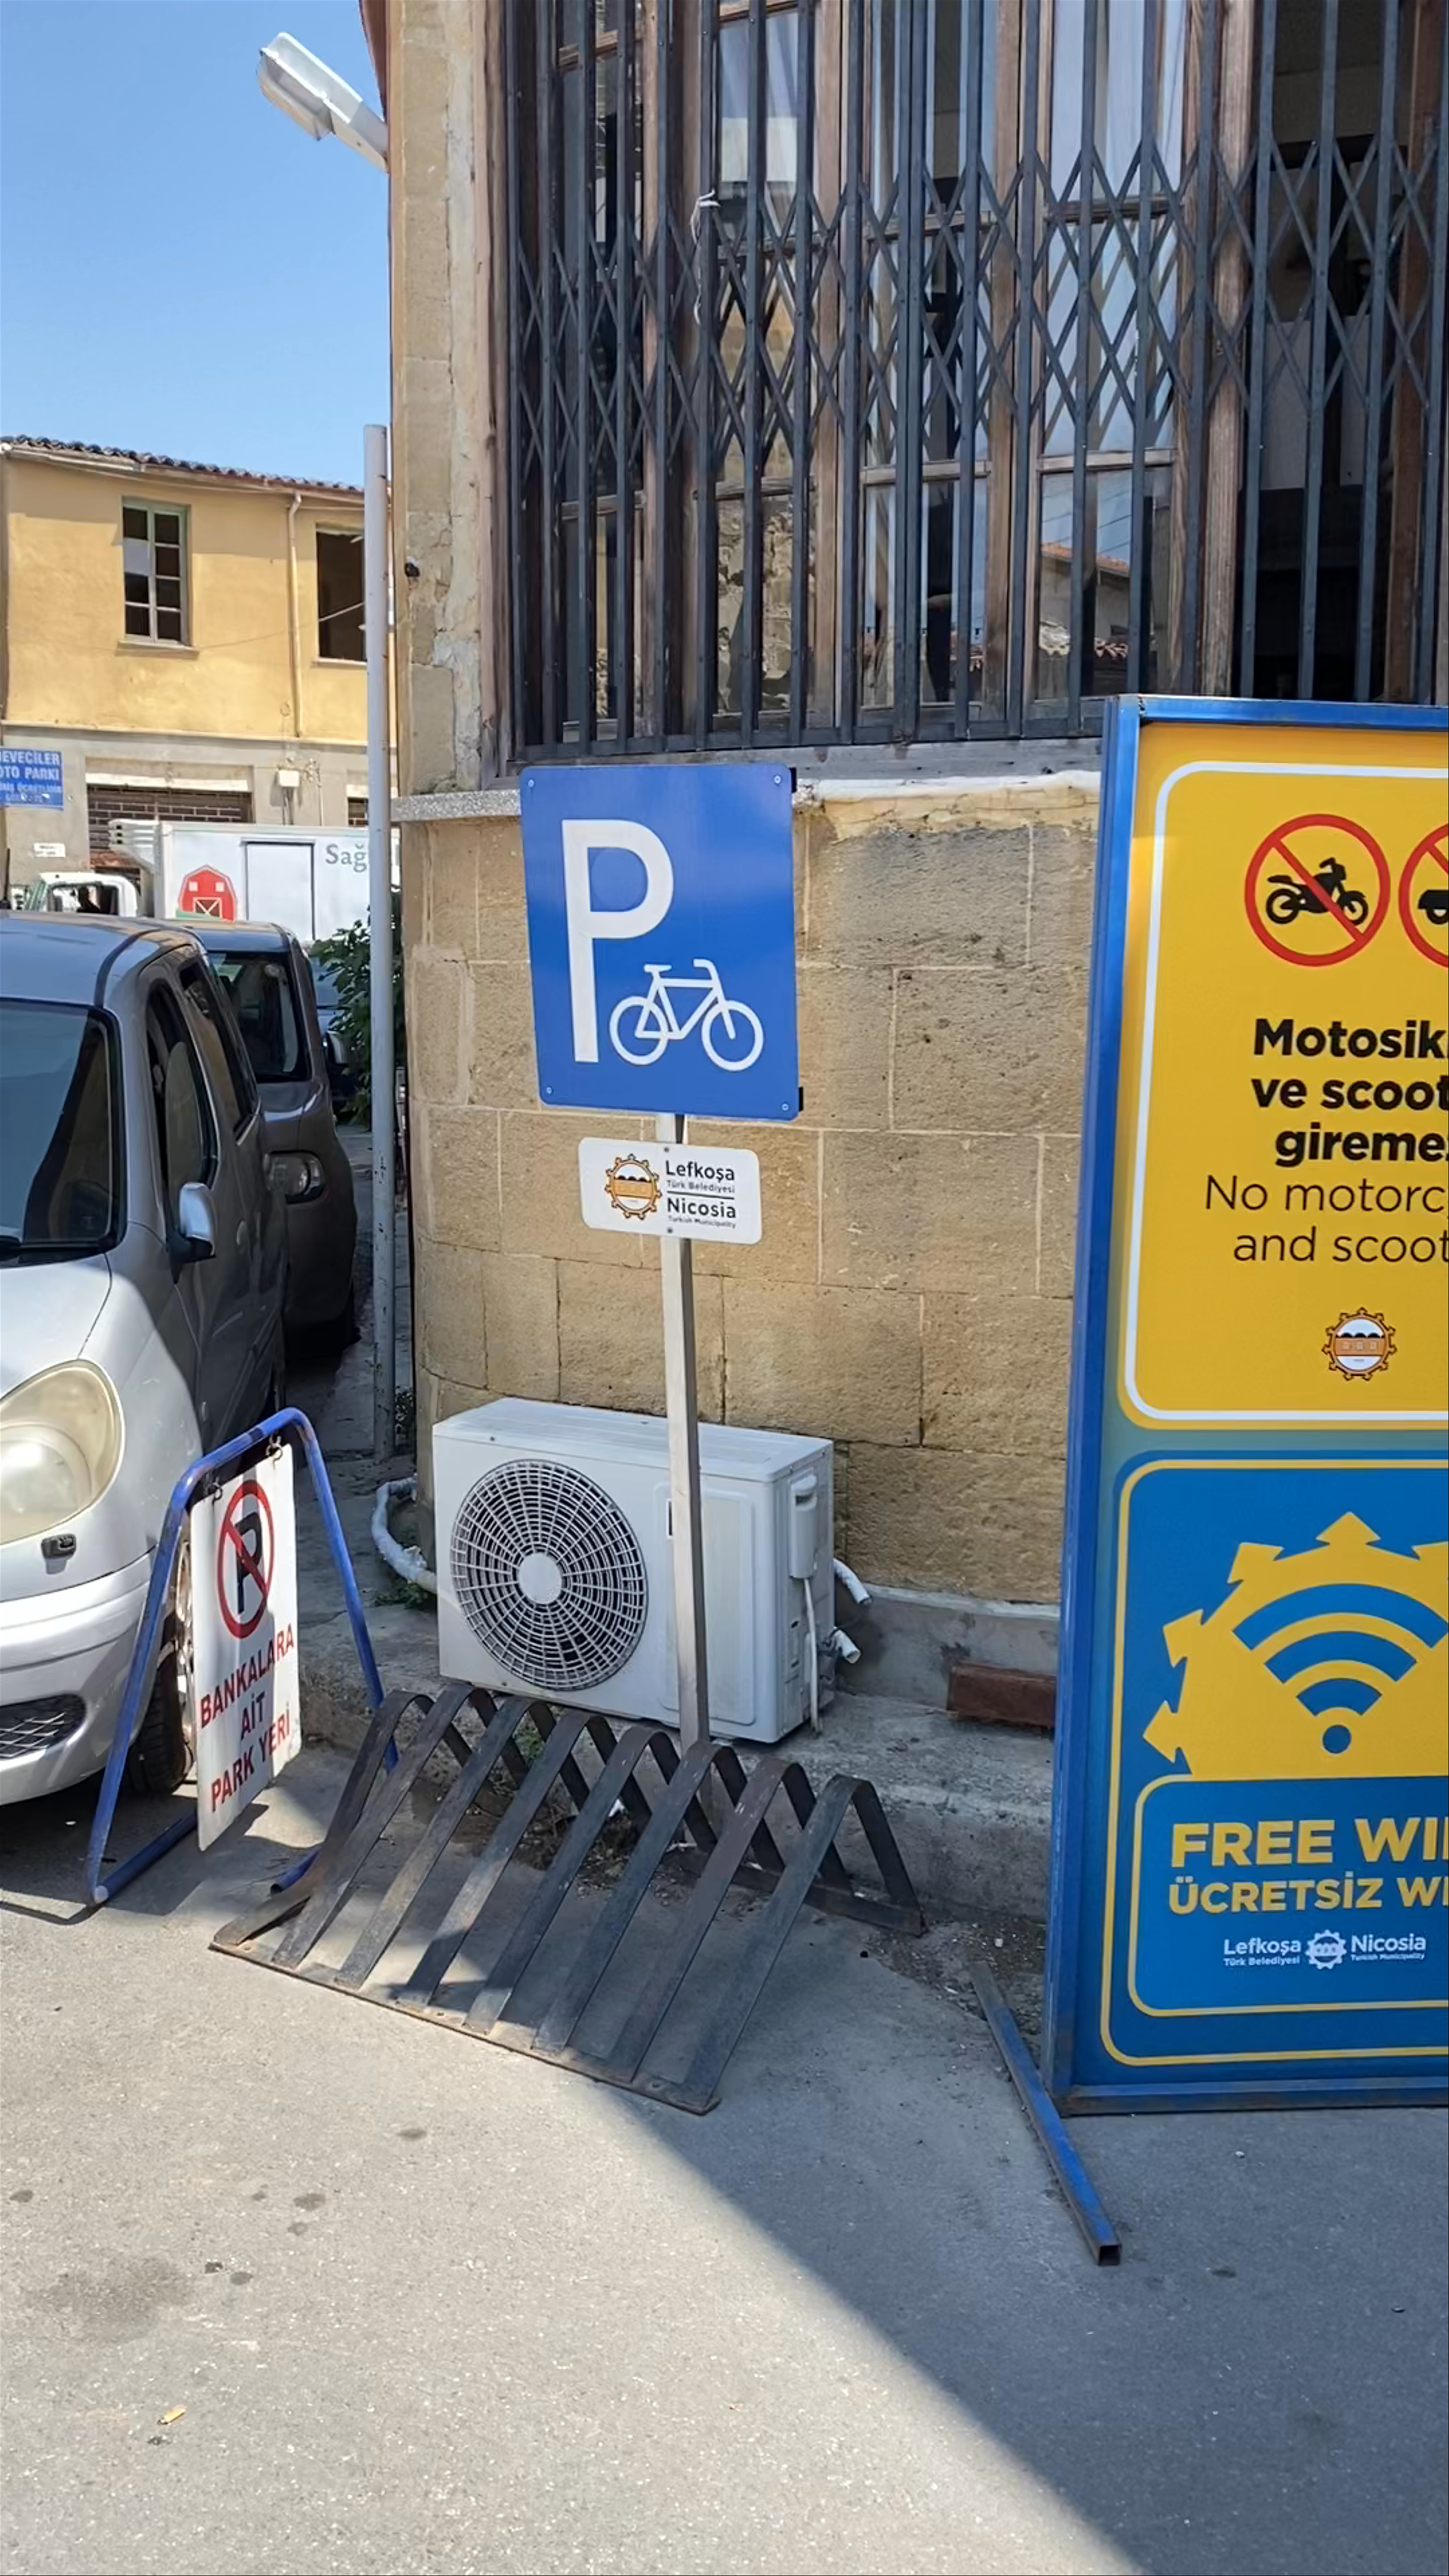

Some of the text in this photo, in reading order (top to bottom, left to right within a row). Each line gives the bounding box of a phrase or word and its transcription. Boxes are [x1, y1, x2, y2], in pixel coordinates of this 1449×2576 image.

[0, 750, 60, 765] EVECİLER
[561, 820, 674, 1063] P
[1254, 1018, 1448, 1058] Motosik
[1251, 1079, 1307, 1108] ve
[1275, 1122, 1448, 1167] gireme
[666, 1160, 734, 1183] Lefkoşa
[667, 1180, 735, 1193] Türk Belediyesi
[667, 1197, 736, 1218] Nicosia
[1206, 1175, 1448, 1221] No motorc
[1234, 1226, 1316, 1261] and
[200, 1624, 294, 1729] BANKALARA
[240, 1691, 265, 1741] AİT
[211, 1701, 290, 1812] PARK YERİ
[1172, 1817, 1448, 1867] FREE WI
[1170, 1871, 1384, 1914] ÜCRETSİZ
[1224, 1933, 1426, 1956] Lefkoşa Nicosia
[1224, 1957, 1246, 1966] Türk
[1248, 1956, 1300, 1966] Belediyesi
[1380, 1952, 1425, 1961] Municipality
